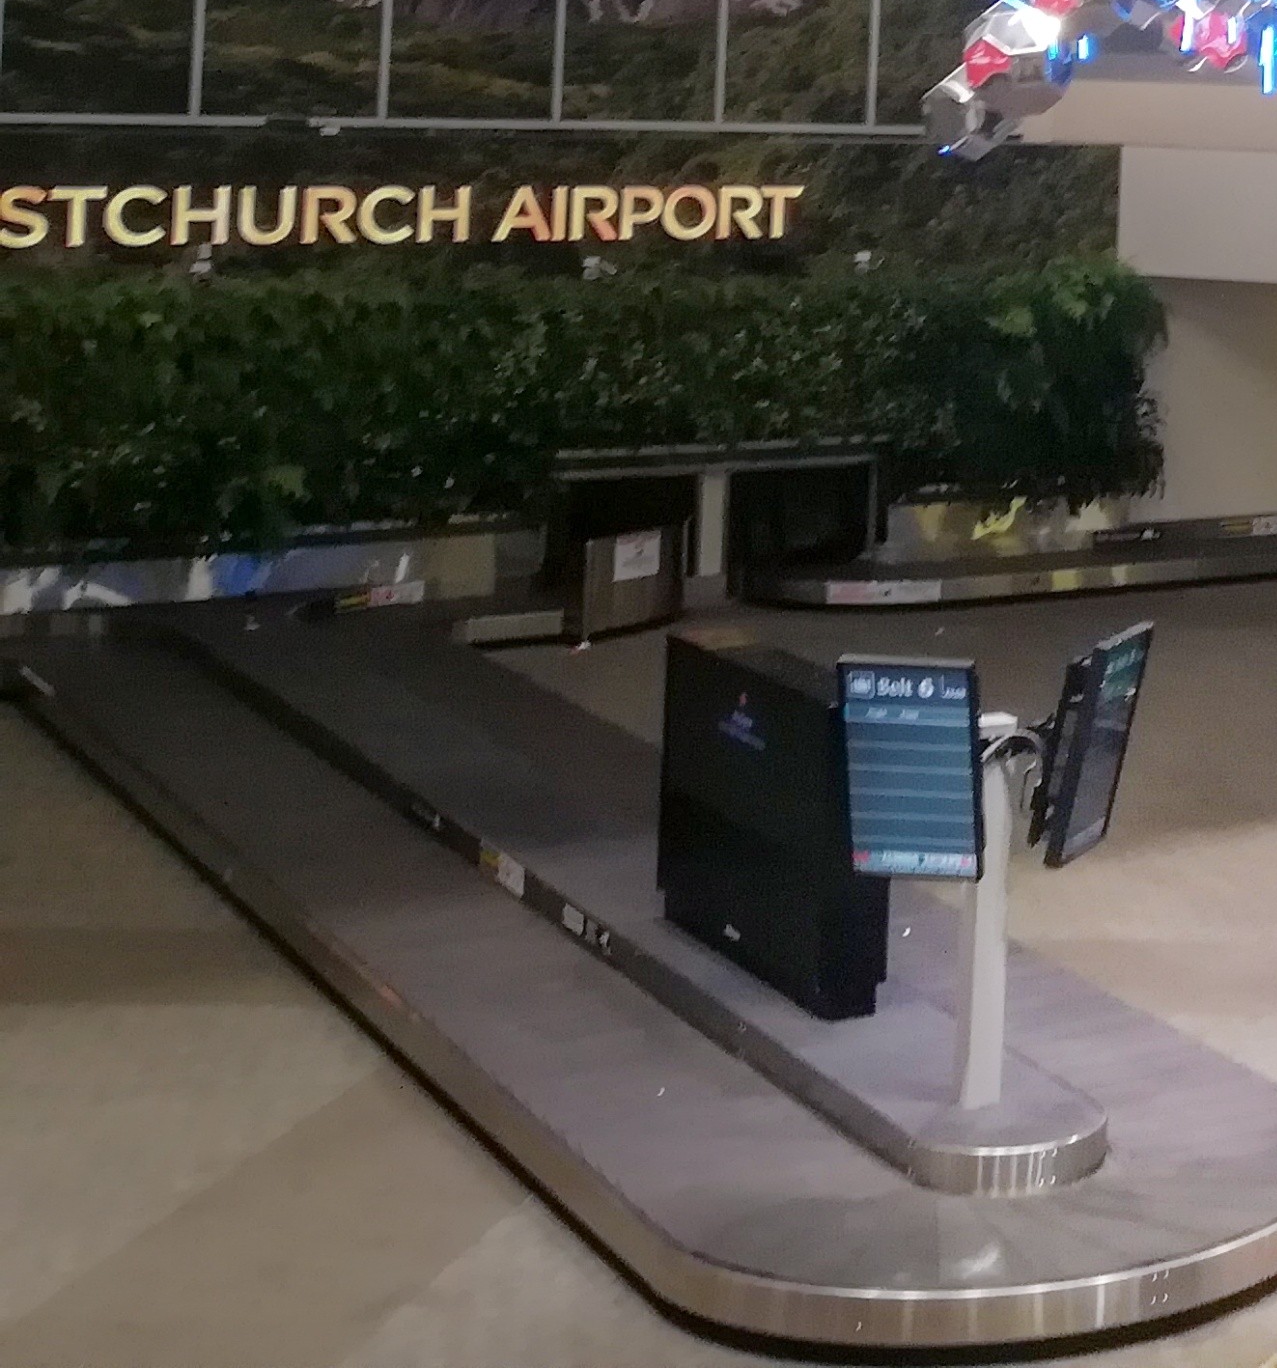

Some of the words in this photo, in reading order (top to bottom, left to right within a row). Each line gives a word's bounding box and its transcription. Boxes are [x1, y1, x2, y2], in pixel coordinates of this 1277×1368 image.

[0, 184, 473, 249] STCHURCH
[491, 184, 805, 243] AIRPORT
[876, 676, 914, 698] Belt
